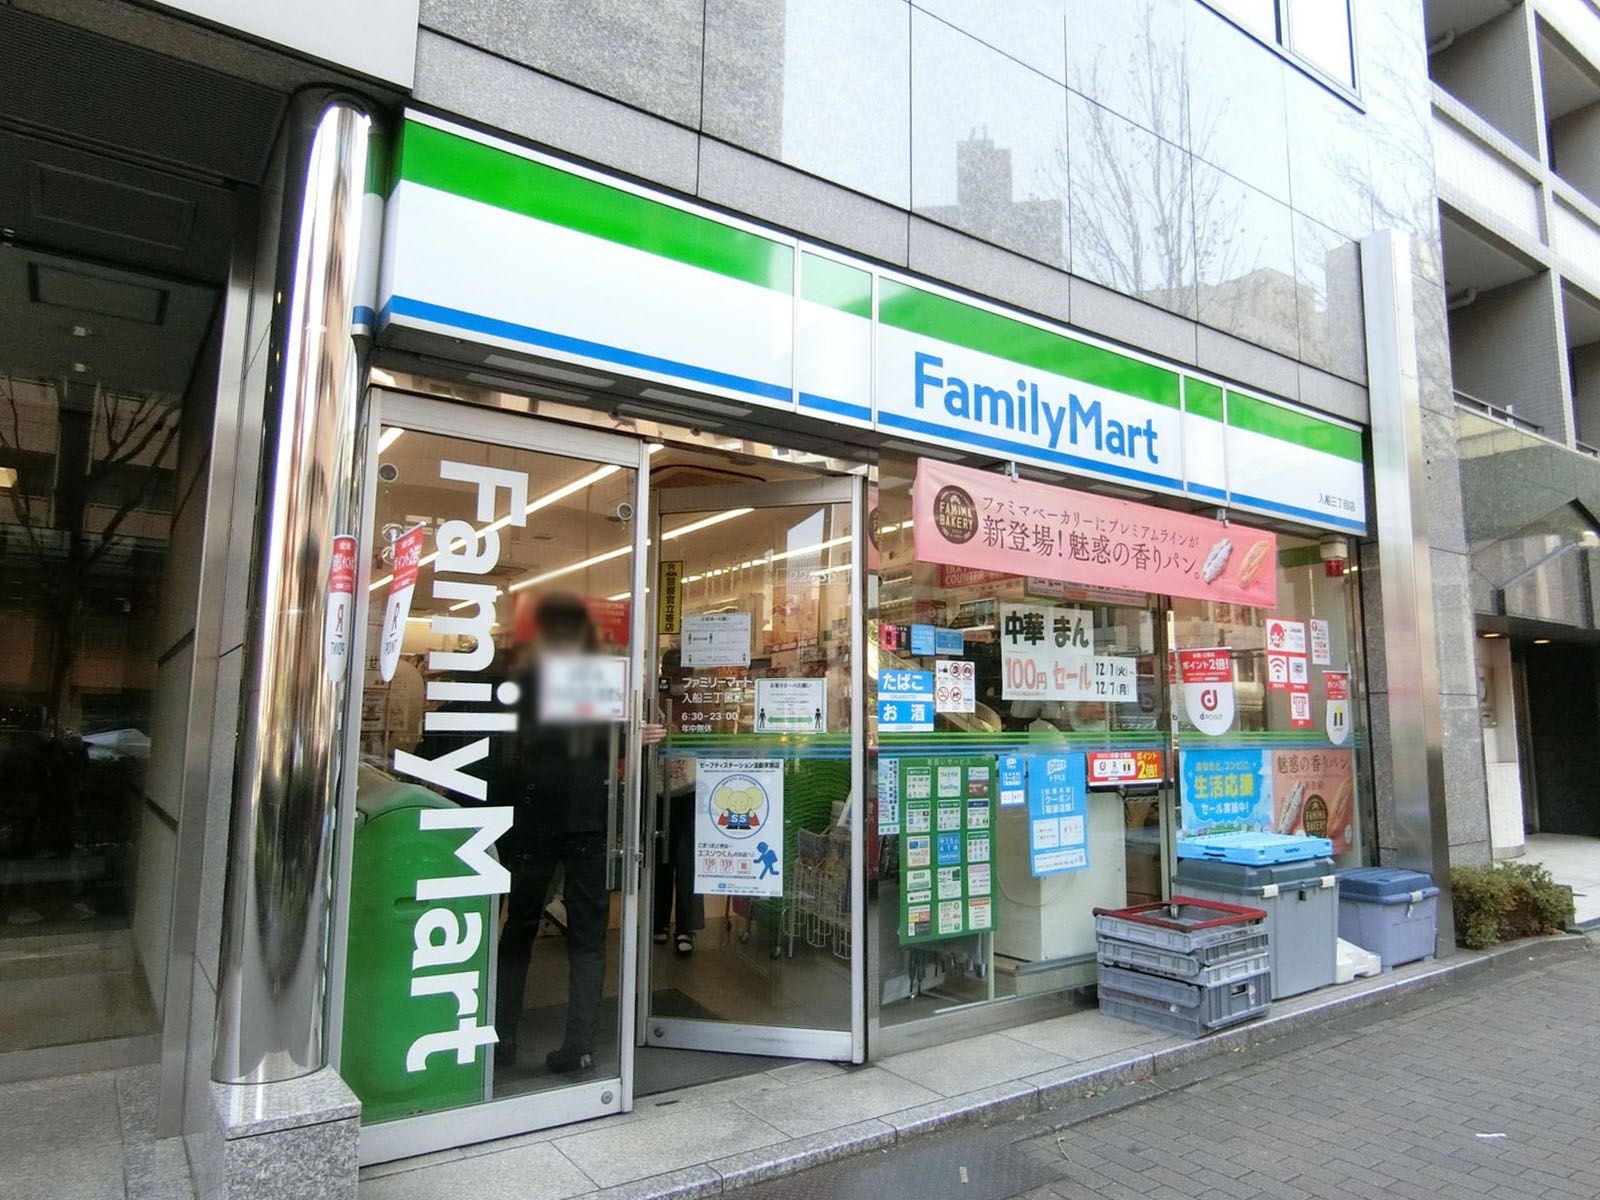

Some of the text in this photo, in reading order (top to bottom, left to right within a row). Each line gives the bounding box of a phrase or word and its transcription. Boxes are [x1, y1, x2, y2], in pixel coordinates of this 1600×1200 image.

[914, 351, 1159, 465] FamilyMart
[939, 514, 973, 530] BAKERY
[982, 496, 1200, 549] ファミマベーカリーにプレミアムラインが
[982, 515, 1201, 580] 新登場!魅惑の香りパン。
[682, 676, 753, 689] ファミリーマート
[883, 672, 924, 691] たばこ
[682, 692, 745, 704] 入船三丁目店
[681, 724, 713, 733] 年中無休
[1136, 752, 1158, 760] ポイント
[1276, 754, 1349, 775] 魅惑の香りパン
[394, 460, 529, 1073] FamilyMart
[1194, 773, 1254, 799] 生活応援
